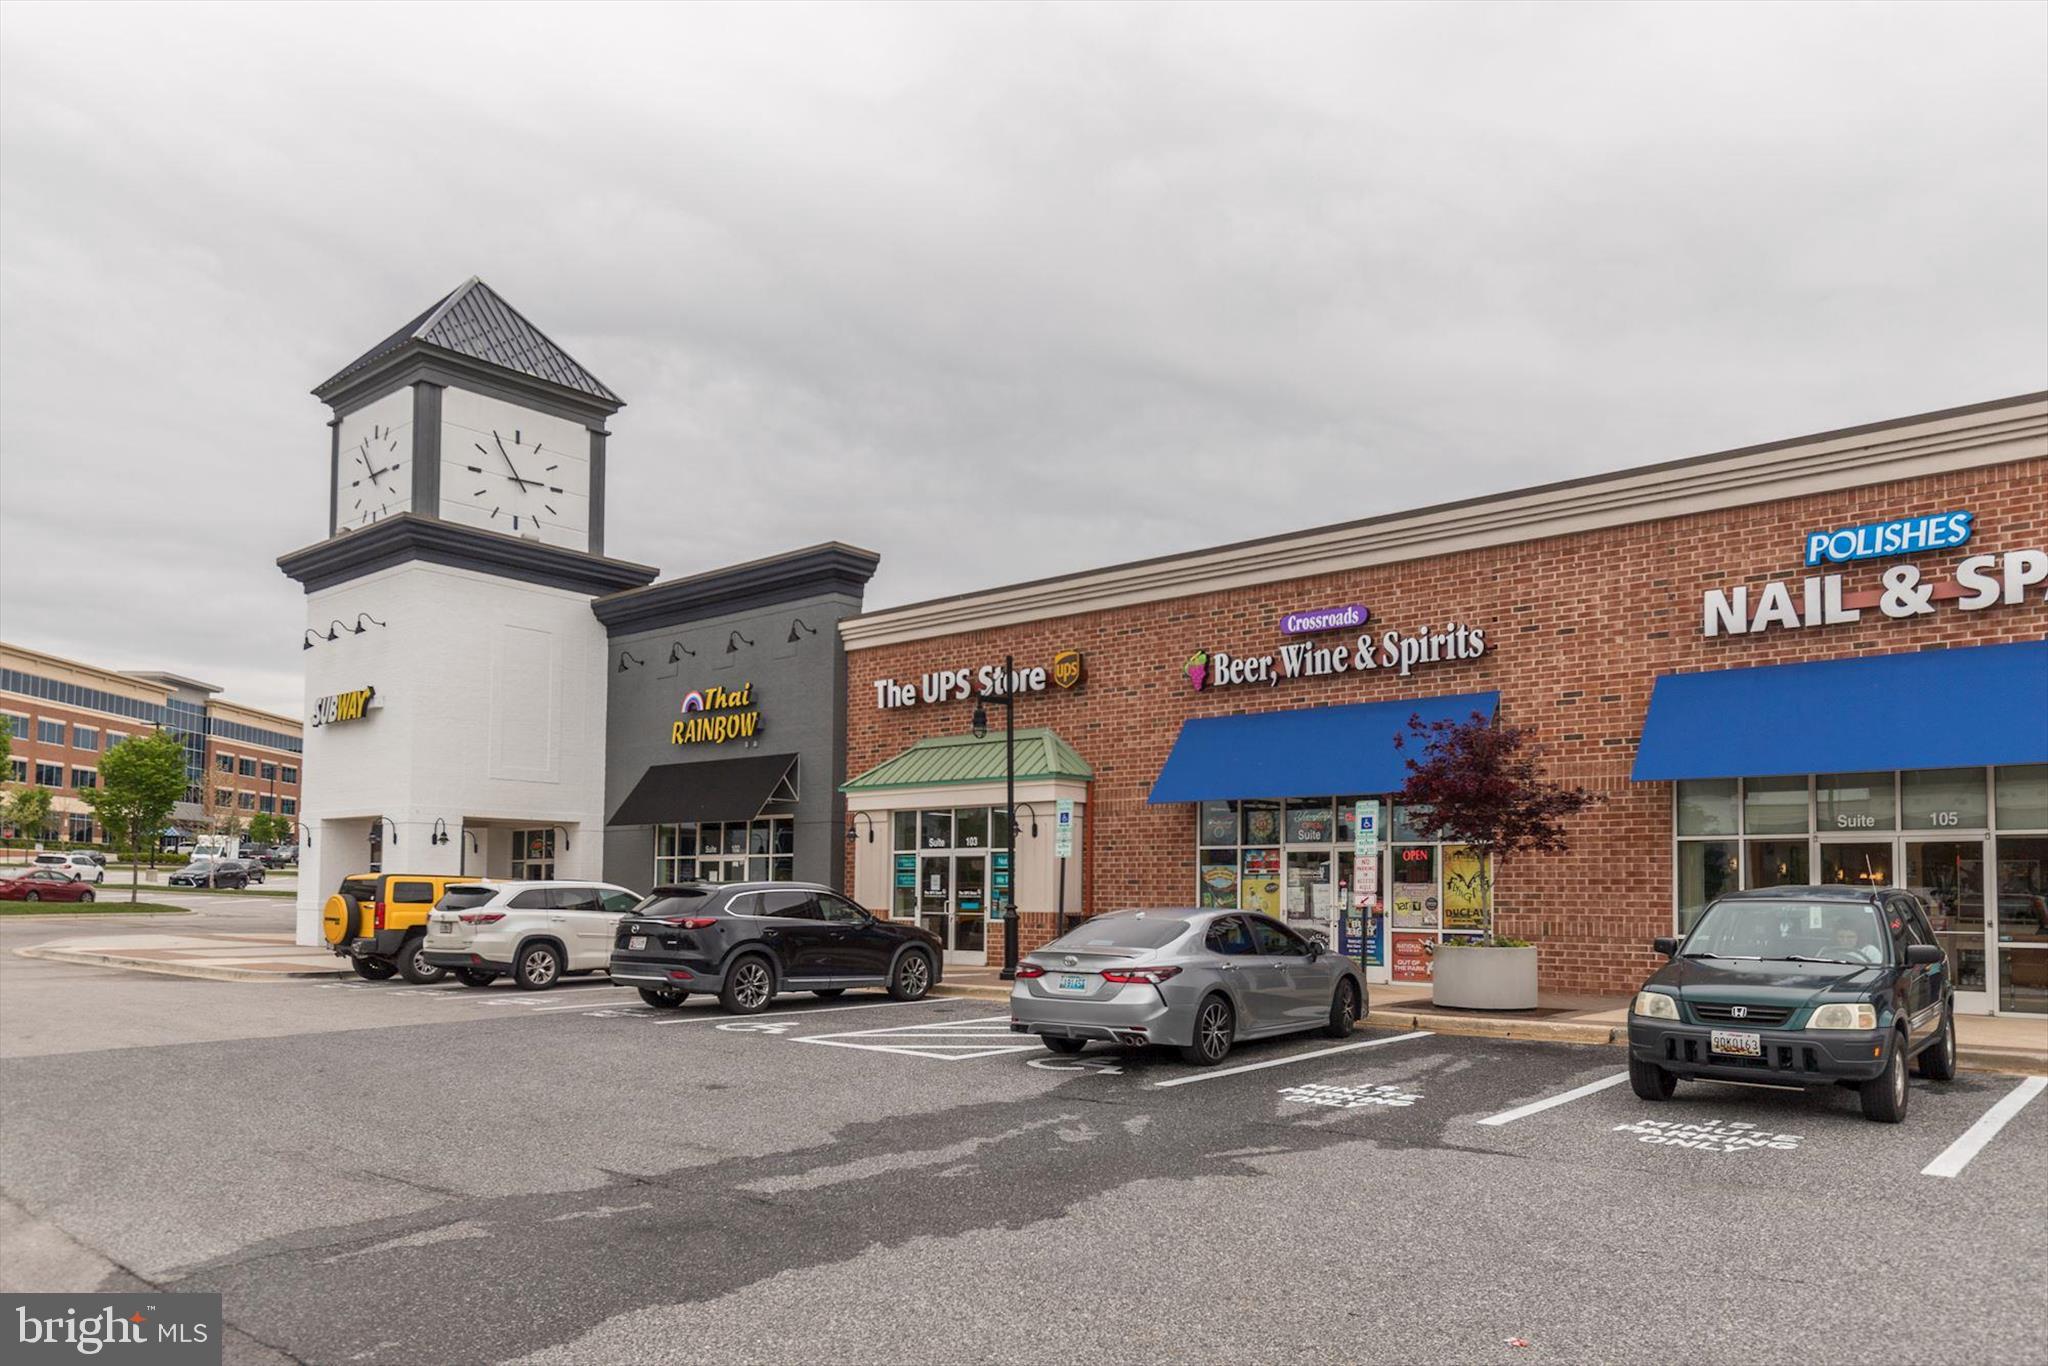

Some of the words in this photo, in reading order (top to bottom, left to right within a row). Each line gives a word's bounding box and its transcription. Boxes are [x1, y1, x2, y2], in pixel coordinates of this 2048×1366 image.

[1809, 514, 1971, 563] POLISHES
[1703, 574, 1860, 637] NAIL
[1879, 565, 1937, 618] &
[1955, 549, 2048, 611] SP
[1287, 606, 1360, 632] Crossroads
[1213, 653, 1277, 687] Beer,
[1279, 641, 1349, 679] Wine
[1354, 634, 1378, 670] &
[1382, 622, 1485, 676] Spirits
[1056, 662, 1078, 682] ups
[704, 682, 751, 711] Thai
[873, 678, 917, 709] The
[921, 668, 972, 704] UPS
[977, 664, 1047, 698] Store
[311, 688, 373, 725] SUBWAY
[671, 711, 758, 745] RAINBOW
[1837, 814, 1875, 828] Suite
[1929, 811, 1958, 826] 105
[928, 837, 946, 848] Suite
[965, 836, 978, 847] 103
[1297, 829, 1321, 840] Suite
[1402, 849, 1428, 861] OPEN
[1612, 1124, 1799, 1150] PARKING
[1636, 1120, 1805, 1142] MINUTE
[1638, 1135, 1751, 1152] ONLY
